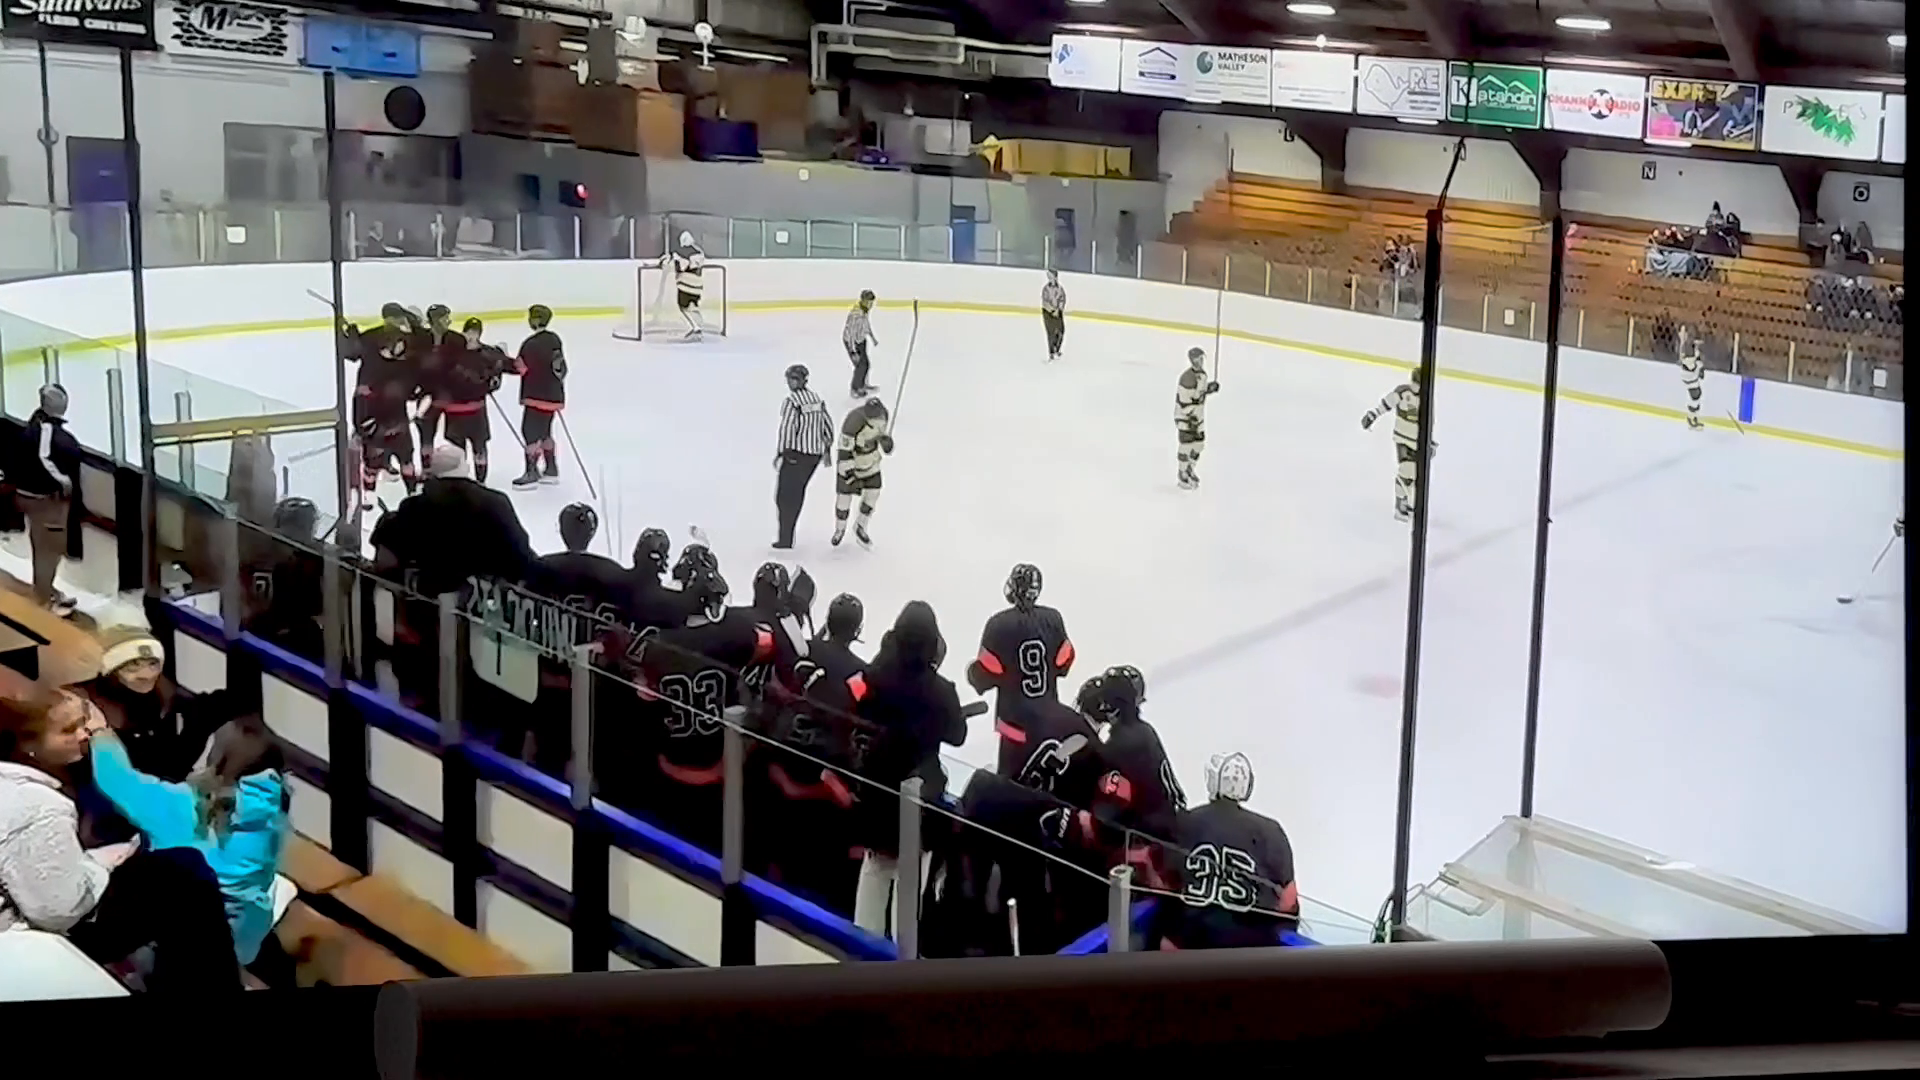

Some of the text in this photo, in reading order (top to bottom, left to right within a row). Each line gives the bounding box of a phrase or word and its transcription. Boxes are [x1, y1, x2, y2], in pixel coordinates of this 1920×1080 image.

[1217, 52, 1268, 64] MATHESON
[1217, 63, 1246, 71] VALLEY
[1642, 165, 1656, 180] N
[1019, 639, 1048, 698] 9
[658, 669, 727, 738] 33
[1180, 843, 1258, 914] 35
